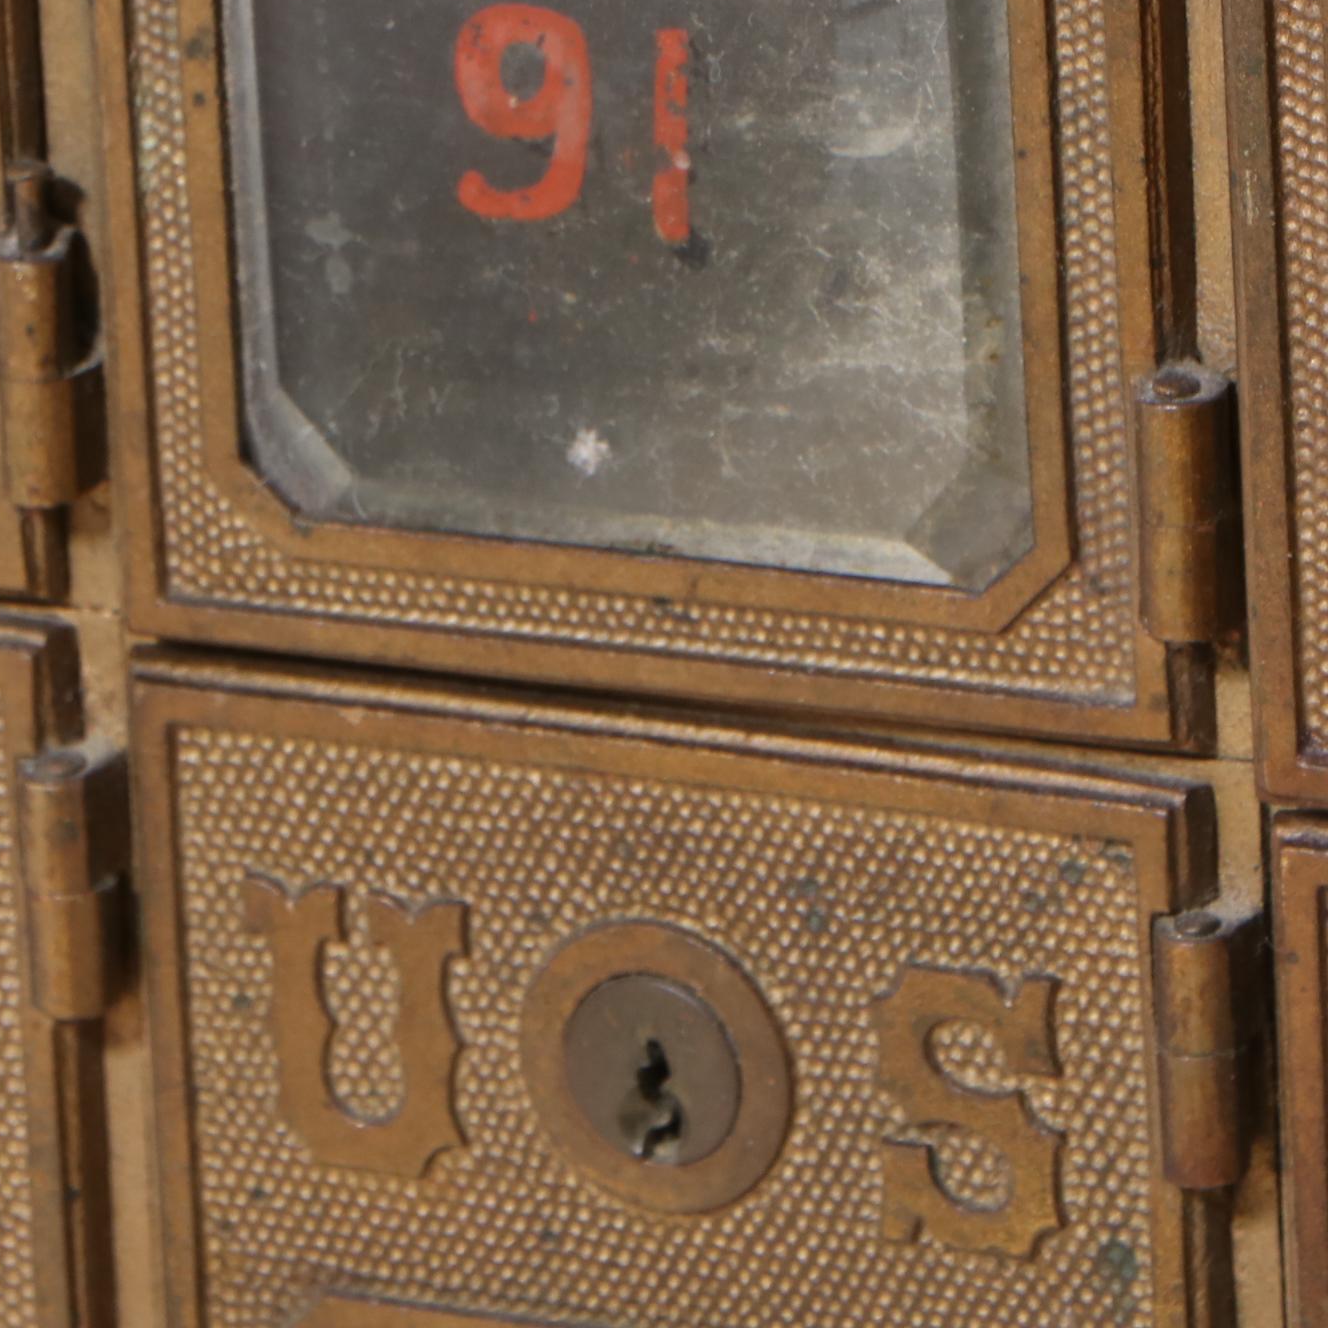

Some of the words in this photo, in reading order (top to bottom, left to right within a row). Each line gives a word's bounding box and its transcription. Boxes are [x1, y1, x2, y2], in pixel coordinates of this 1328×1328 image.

[454, 3, 690, 241] 91
[243, 873, 469, 1179] U
[875, 960, 1068, 1262] S
